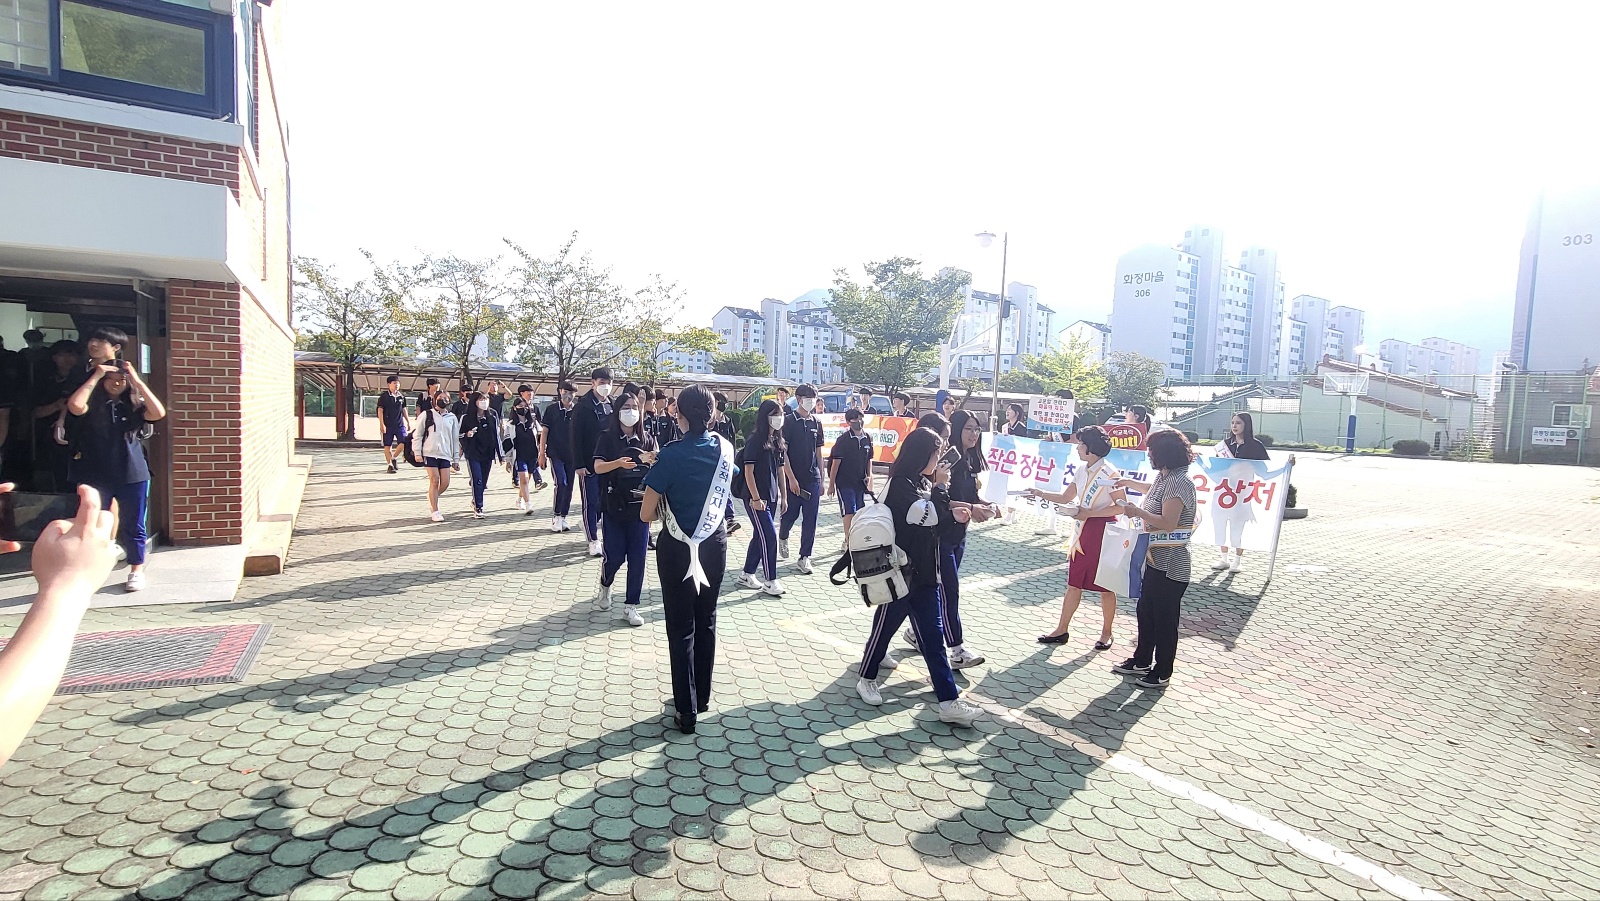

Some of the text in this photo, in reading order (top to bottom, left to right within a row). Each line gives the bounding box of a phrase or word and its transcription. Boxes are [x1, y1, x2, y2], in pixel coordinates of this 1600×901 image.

[1562, 233, 1594, 247] 303
[1123, 270, 1164, 285] 화정마을
[1134, 289, 1151, 298] 306
[987, 447, 1018, 475] 작은
[1020, 453, 1056, 483] 장난
[1214, 478, 1276, 511] 상처
[709, 485, 726, 509] 약자
[700, 511, 718, 533] 보호
